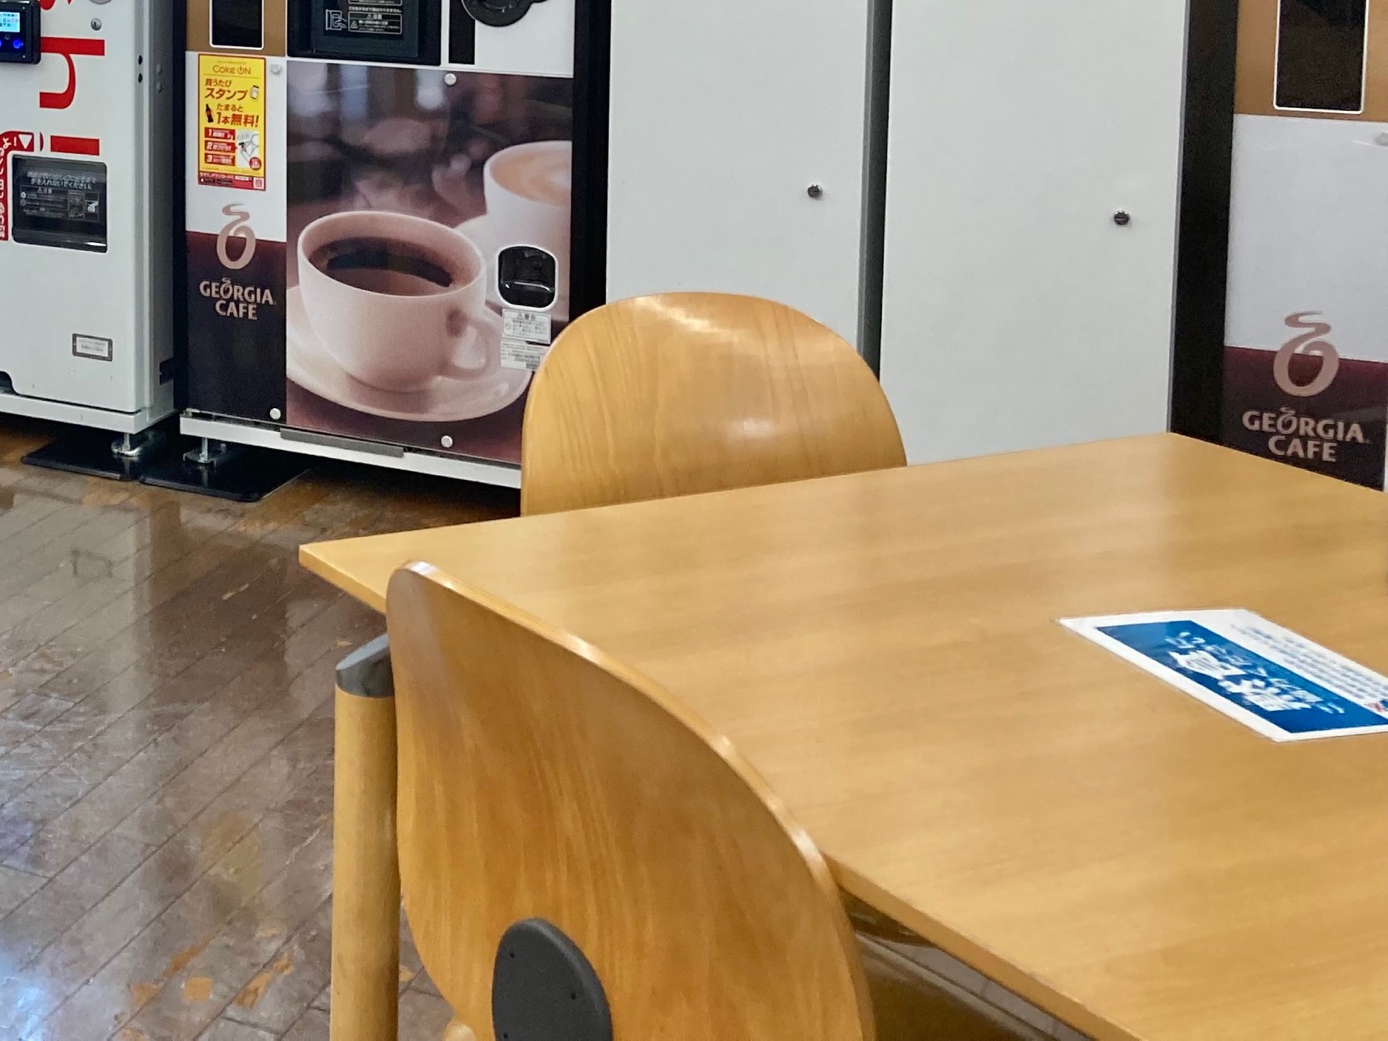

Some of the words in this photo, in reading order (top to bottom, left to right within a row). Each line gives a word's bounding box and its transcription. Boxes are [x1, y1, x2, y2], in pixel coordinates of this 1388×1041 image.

[212, 64, 236, 74] Coke
[205, 78, 232, 87] 買うたび
[204, 87, 248, 101] スタンプ
[216, 103, 243, 112] たまると
[199, 278, 275, 306] GEORGIA
[215, 300, 258, 320] CAFE
[1242, 406, 1365, 444] GEORGIA
[1268, 435, 1338, 463] CAFE
